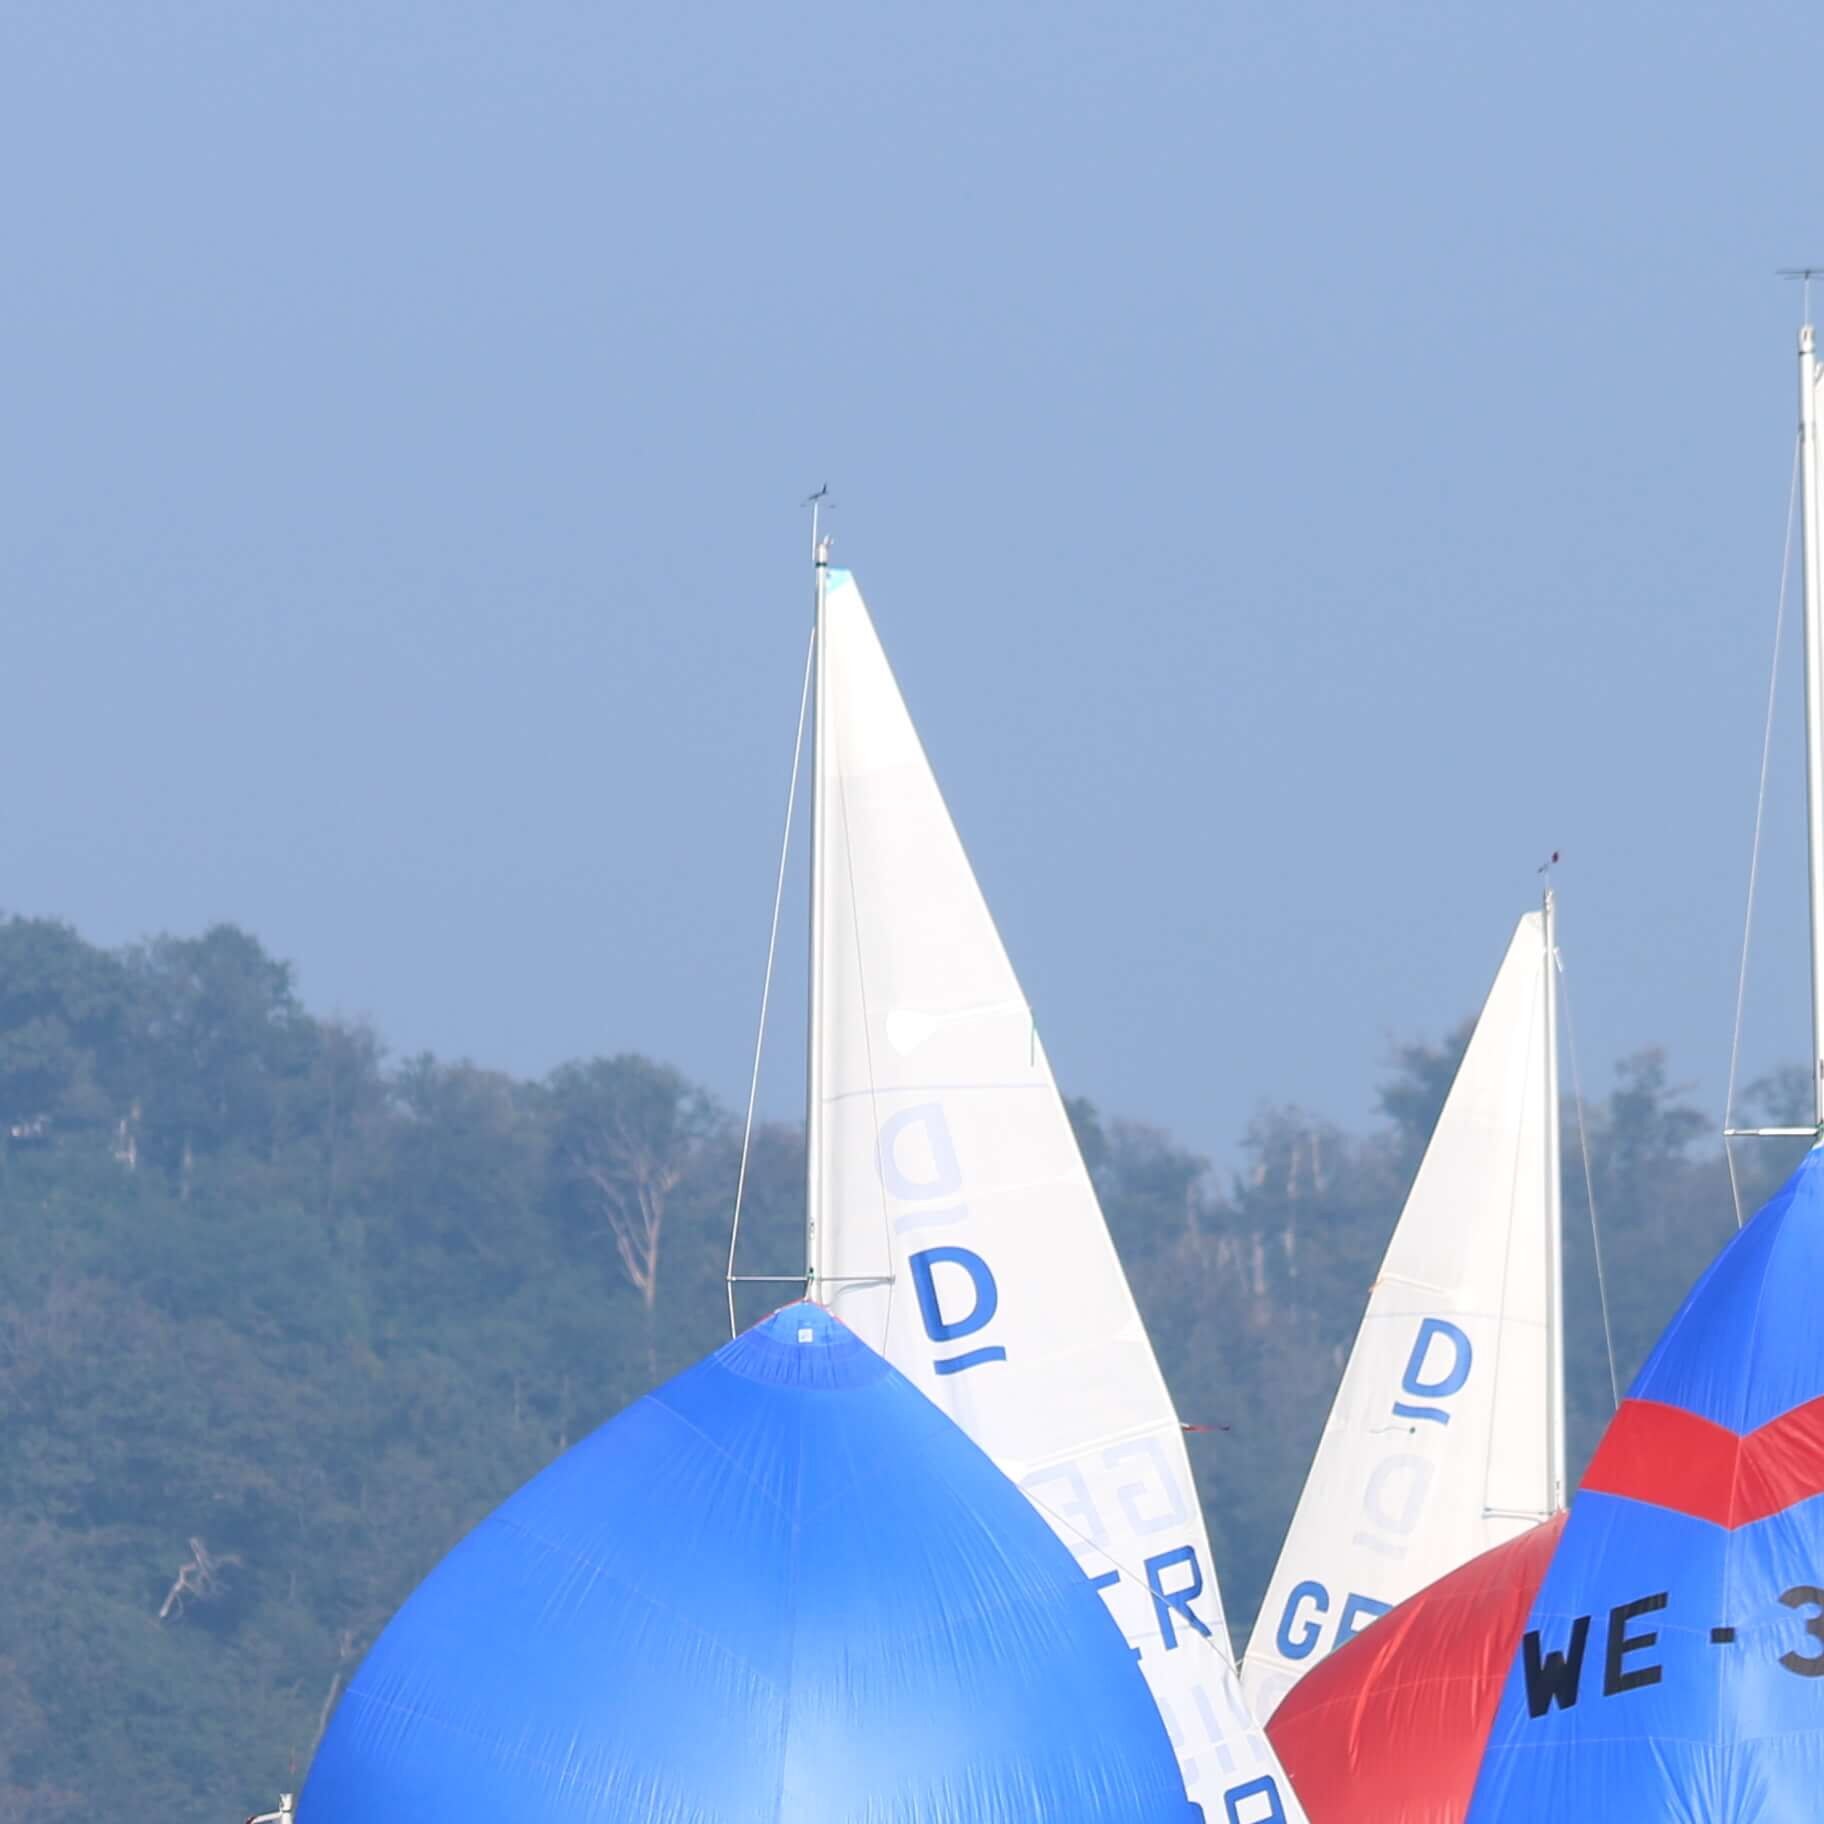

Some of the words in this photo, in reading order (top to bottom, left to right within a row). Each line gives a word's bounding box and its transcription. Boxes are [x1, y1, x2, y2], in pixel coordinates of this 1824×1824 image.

[909, 1247, 998, 1343] D
[1402, 1318, 1473, 1398] D
[1522, 1591, 1668, 1719] WE
